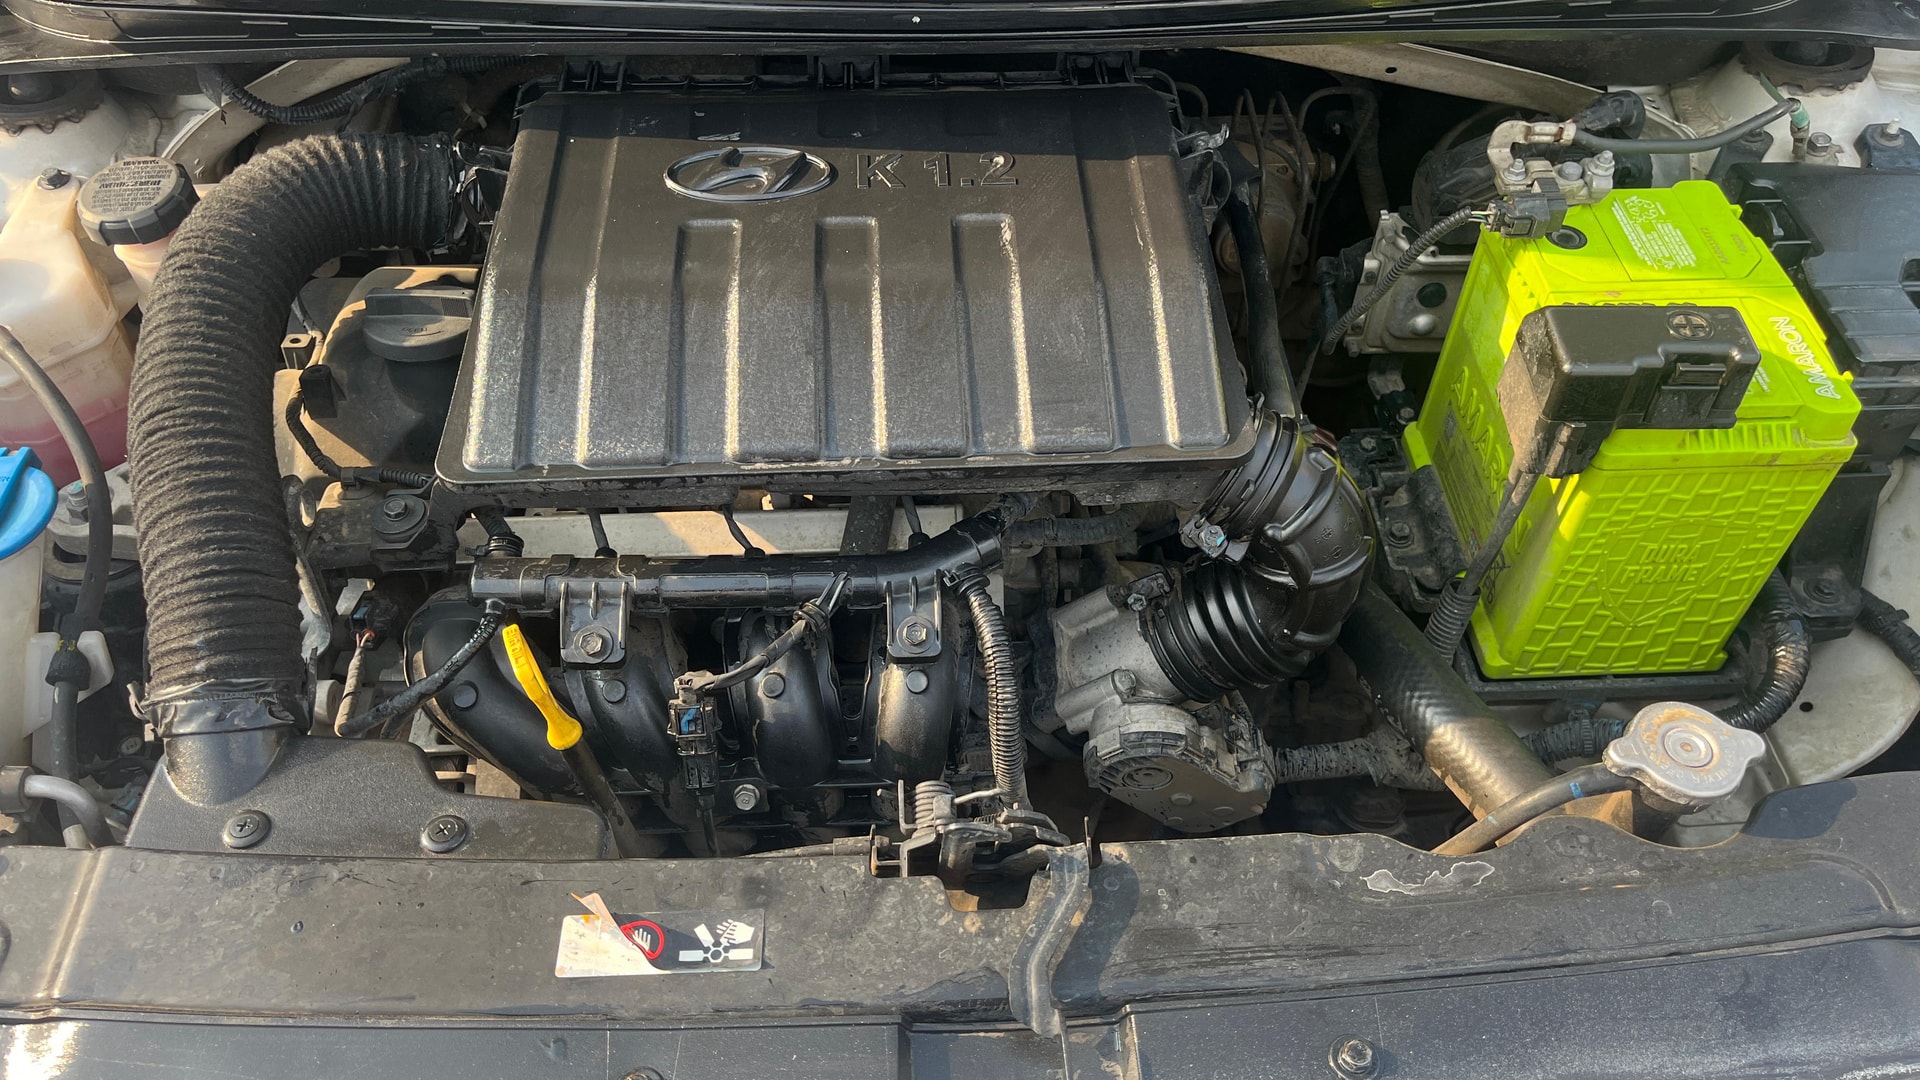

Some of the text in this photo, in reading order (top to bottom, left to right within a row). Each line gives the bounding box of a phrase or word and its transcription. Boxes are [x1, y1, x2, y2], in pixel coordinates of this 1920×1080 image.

[857, 151, 1018, 189] K 1.2
[1769, 317, 1841, 399] AMARON
[1640, 545, 1701, 563] DURA
[1620, 564, 1703, 584] FRAME
